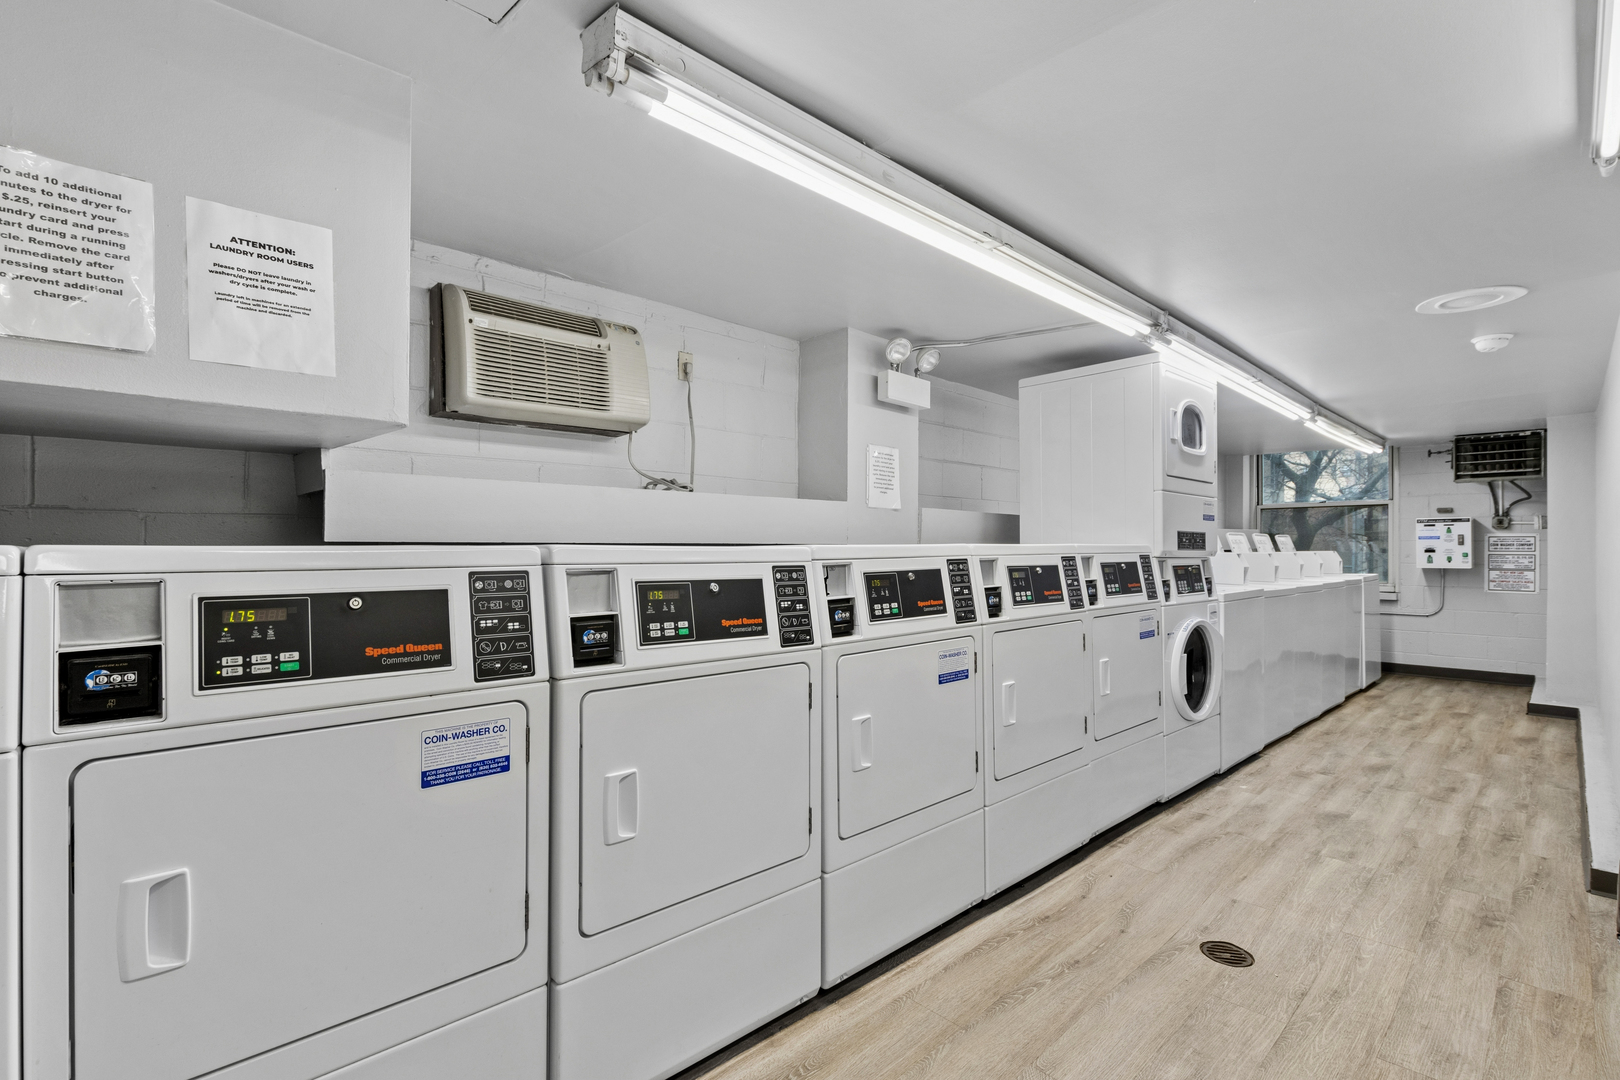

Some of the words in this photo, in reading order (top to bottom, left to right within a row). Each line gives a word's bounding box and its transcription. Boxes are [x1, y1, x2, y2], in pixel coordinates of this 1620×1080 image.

[15, 170, 39, 181] add
[44, 176, 58, 185] 10
[62, 182, 122, 200] additional
[2, 192, 33, 206] $.25,
[38, 202, 87, 217] reinsert
[91, 213, 116, 223] your
[40, 188, 54, 197] to
[58, 192, 77, 202] the
[81, 198, 113, 210] dryer
[116, 206, 132, 215] for
[26, 224, 66, 240] during
[82, 236, 126, 250] running
[40, 215, 68, 225] card
[72, 221, 94, 231] and
[98, 227, 129, 238] press
[4, 245, 82, 266] immediately
[86, 260, 114, 270] after
[28, 236, 78, 252] Remove
[81, 247, 100, 256] the
[104, 252, 130, 262] card
[210, 243, 254, 258] LAUNDRY
[257, 253, 284, 263] ROOM
[287, 259, 314, 270] USERS
[230, 236, 296, 256] ATTENTION:
[12, 273, 60, 286] prevent
[64, 282, 123, 296] additional
[52, 267, 82, 278] start
[86, 272, 124, 284] button
[208, 269, 259, 282] washers/dryers
[213, 262, 235, 270] Please
[281, 276, 304, 285] laundry
[34, 289, 87, 303] charges.
[242, 282, 259, 290] cycle
[267, 286, 298, 296] complete.
[721, 618, 742, 627] Speed
[365, 644, 404, 657] Speed
[406, 643, 443, 652] Queen
[382, 655, 421, 665] Commercial
[423, 653, 441, 661] Dryer
[424, 727, 490, 745] COIN-WASHER
[492, 725, 507, 733] CO.
